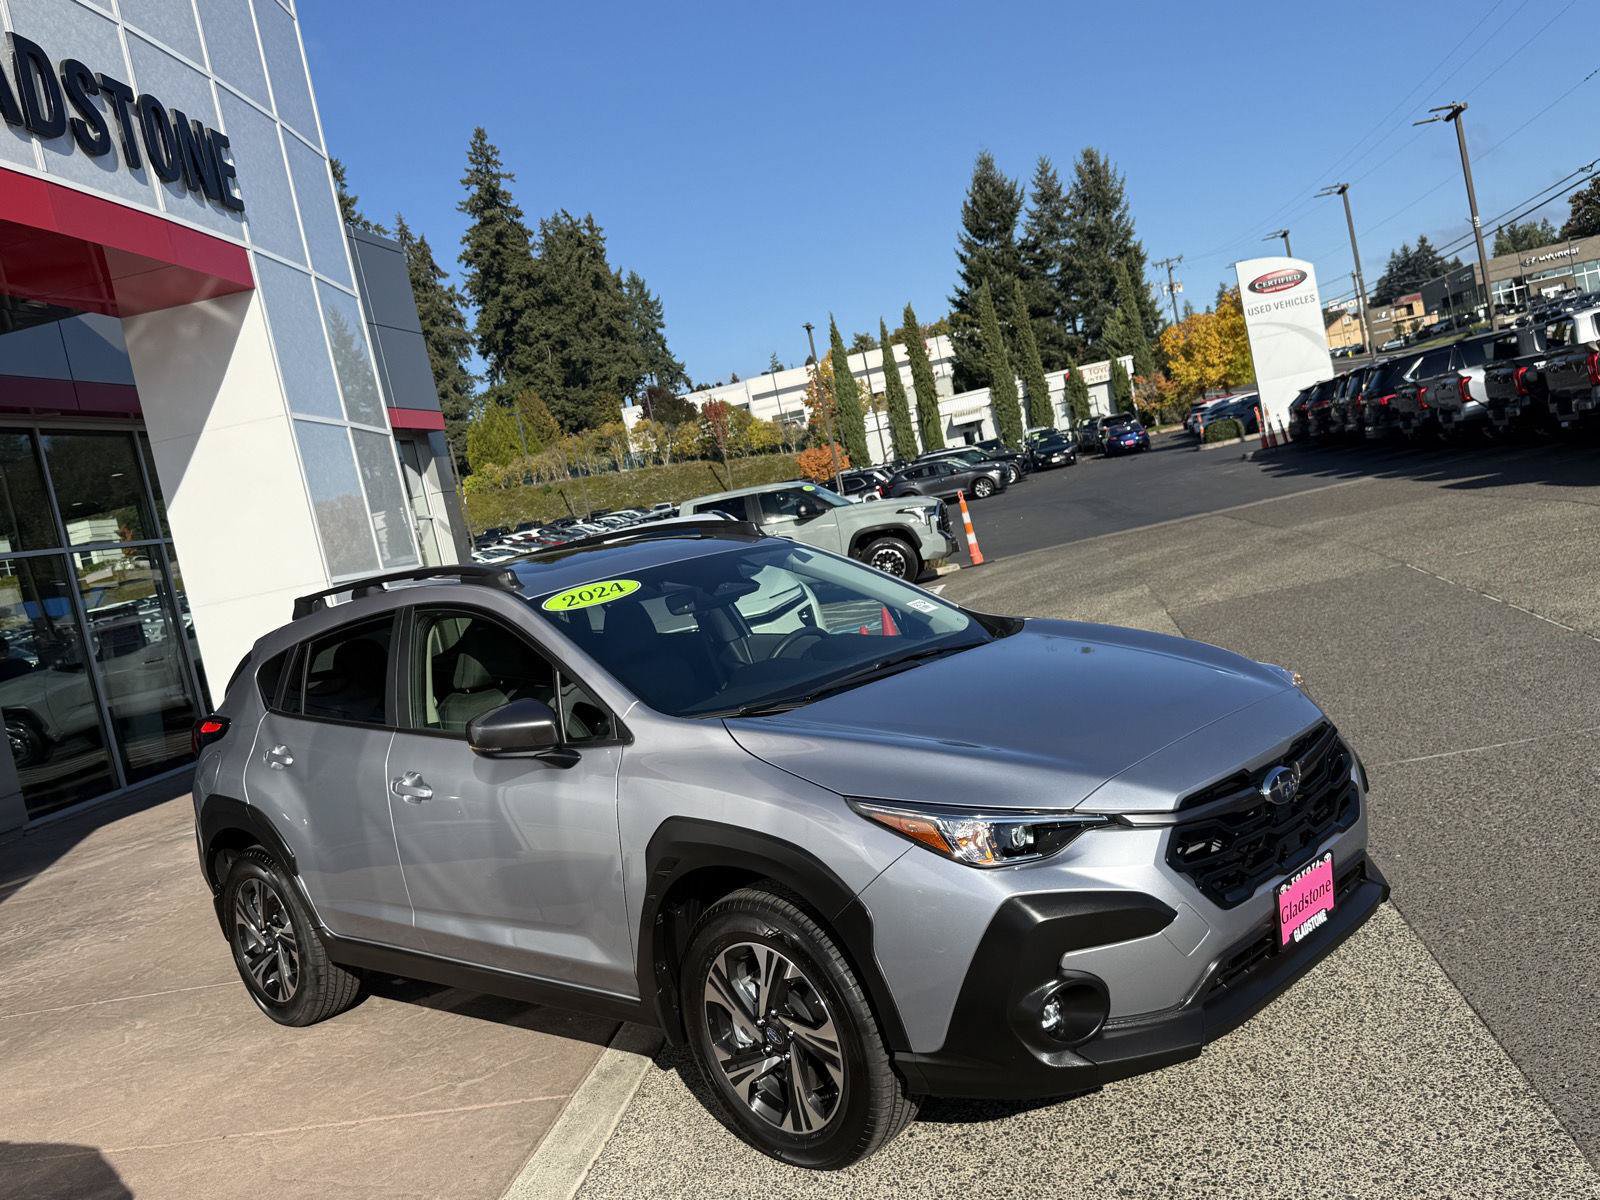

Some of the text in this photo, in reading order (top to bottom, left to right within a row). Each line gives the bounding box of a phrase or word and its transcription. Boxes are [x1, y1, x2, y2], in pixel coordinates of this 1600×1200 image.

[1255, 274, 1300, 289] CERTIFIED
[1247, 304, 1271, 316] USED
[1273, 294, 1316, 310] VEHICLES
[562, 582, 626, 607] 2024
[1281, 880, 1331, 925] Gladstone
[1293, 908, 1328, 943] GLADSTONE
